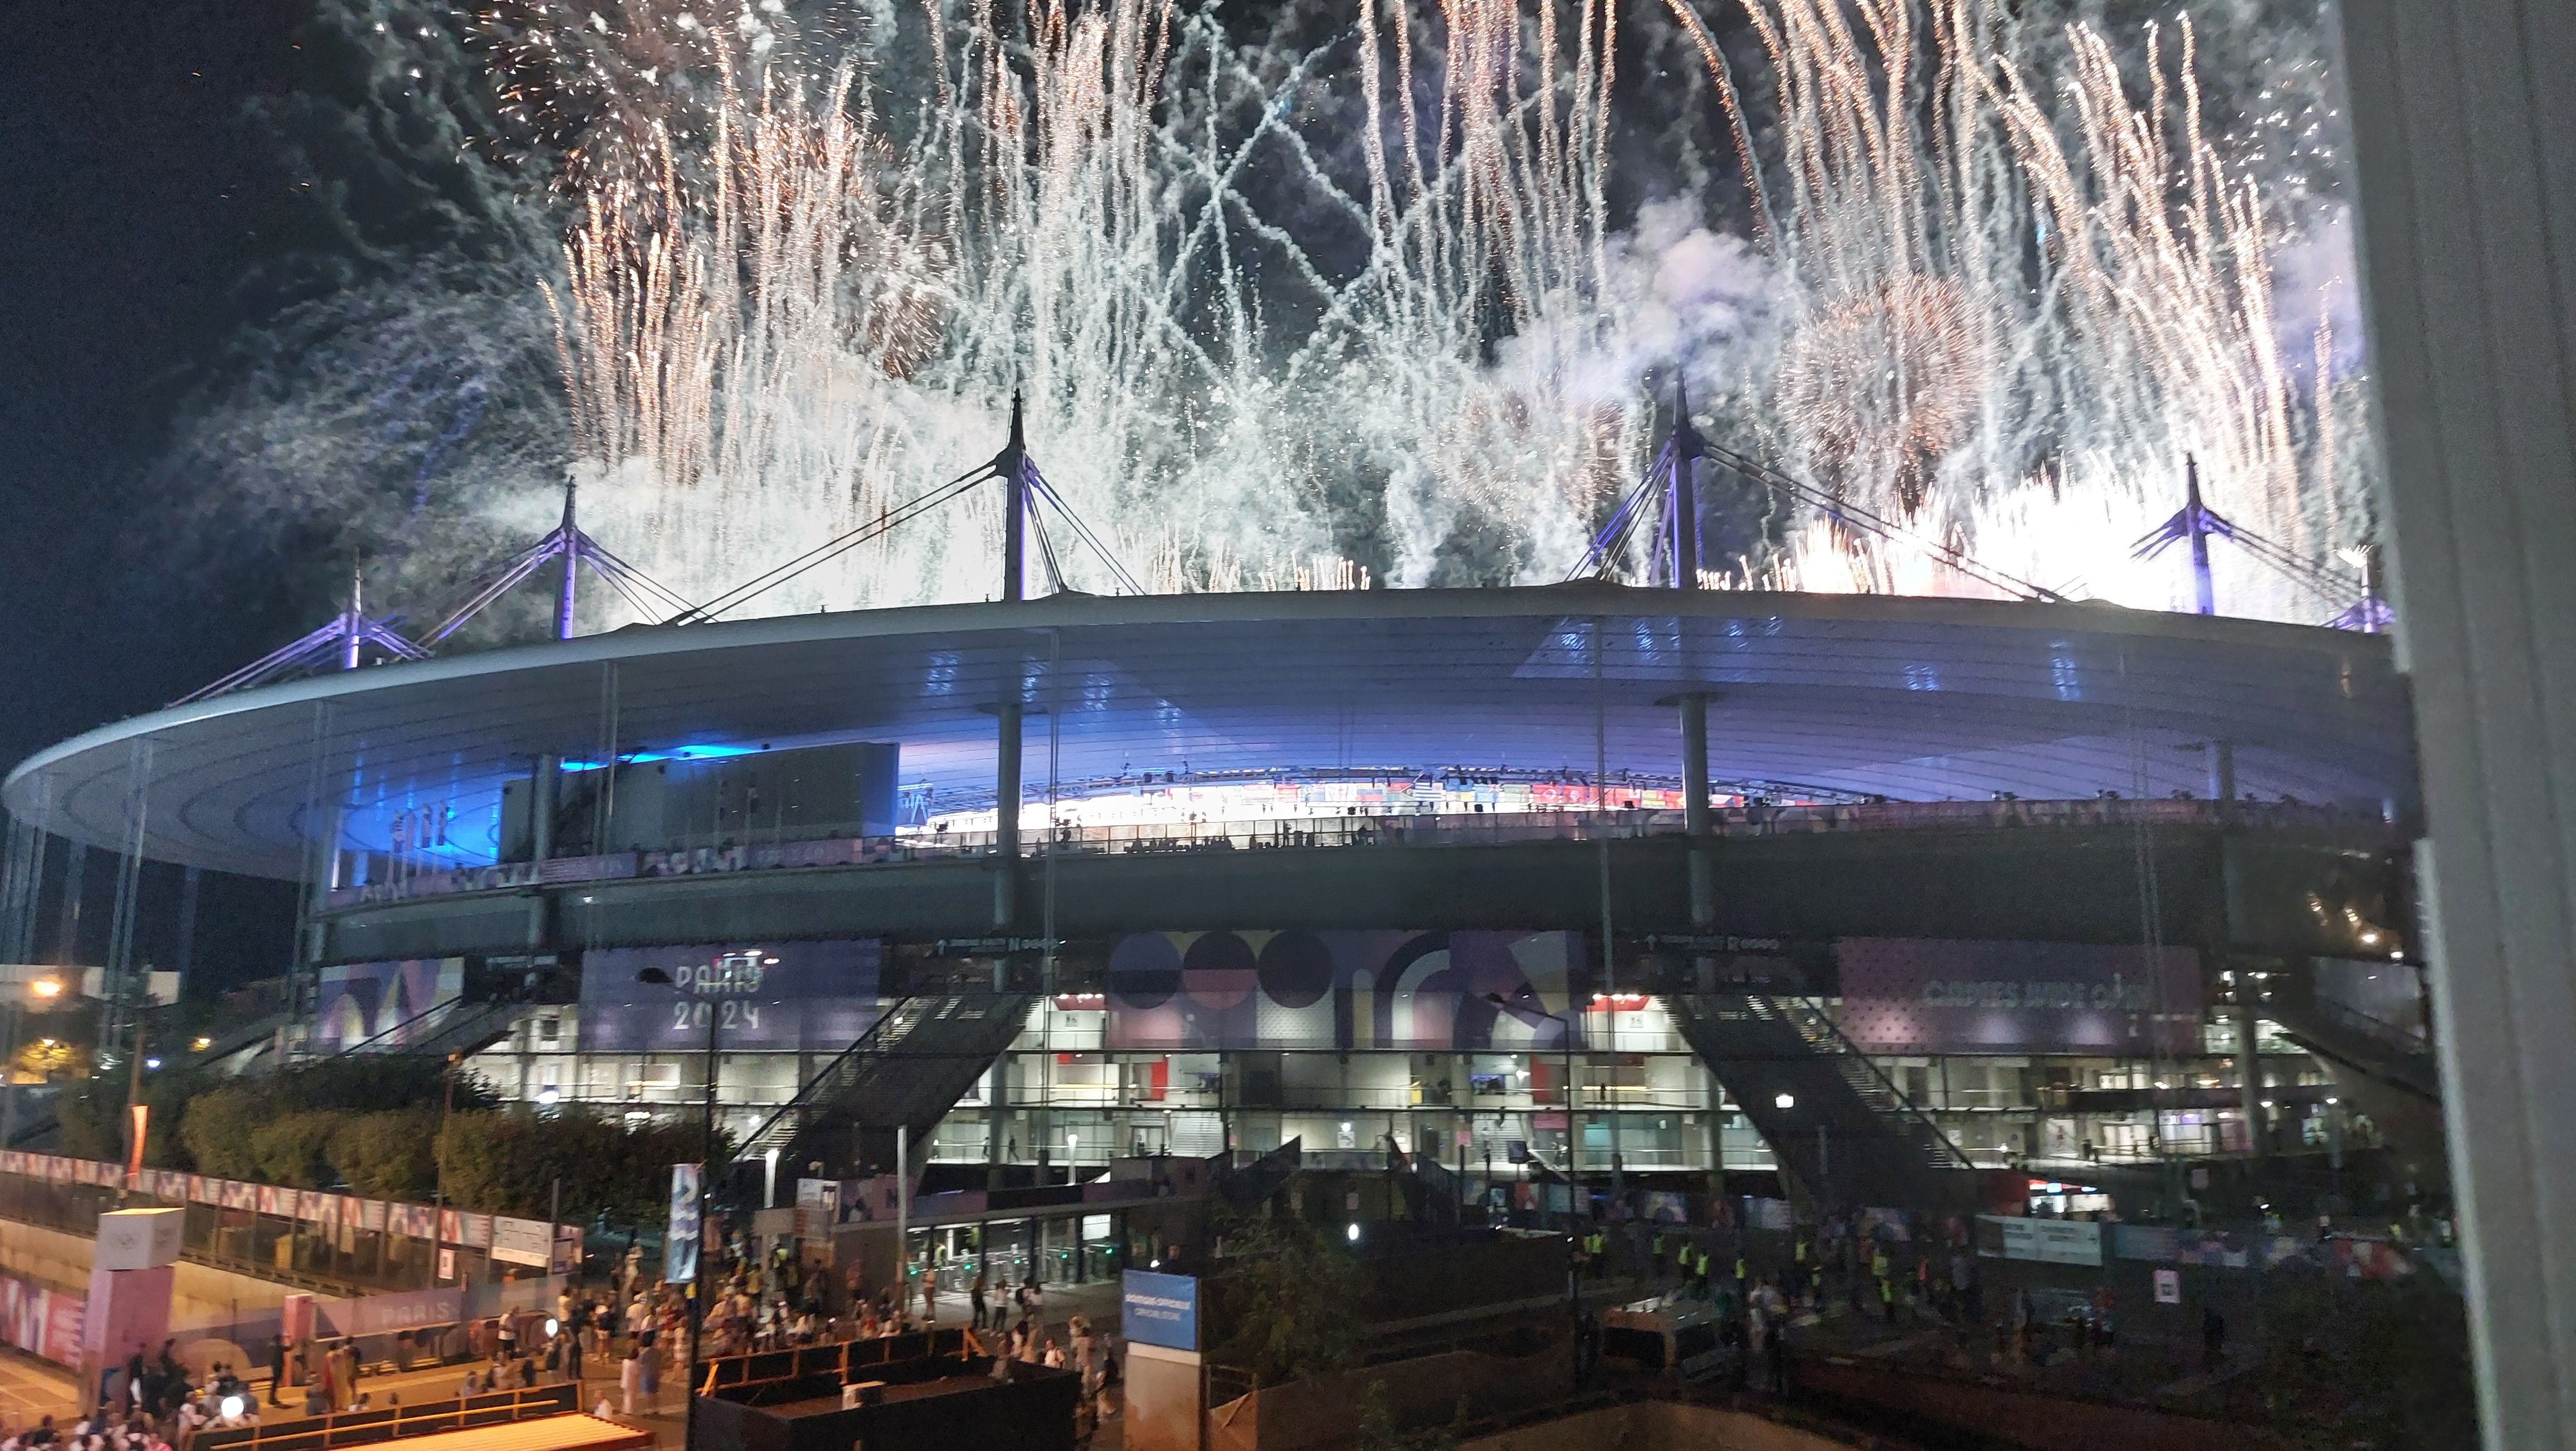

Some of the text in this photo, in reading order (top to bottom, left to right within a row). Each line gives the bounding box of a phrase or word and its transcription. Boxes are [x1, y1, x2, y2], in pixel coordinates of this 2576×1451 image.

[674, 965, 763, 994] PARIS
[672, 1001, 759, 1030] 2024
[381, 1302, 450, 1326] PARIS
